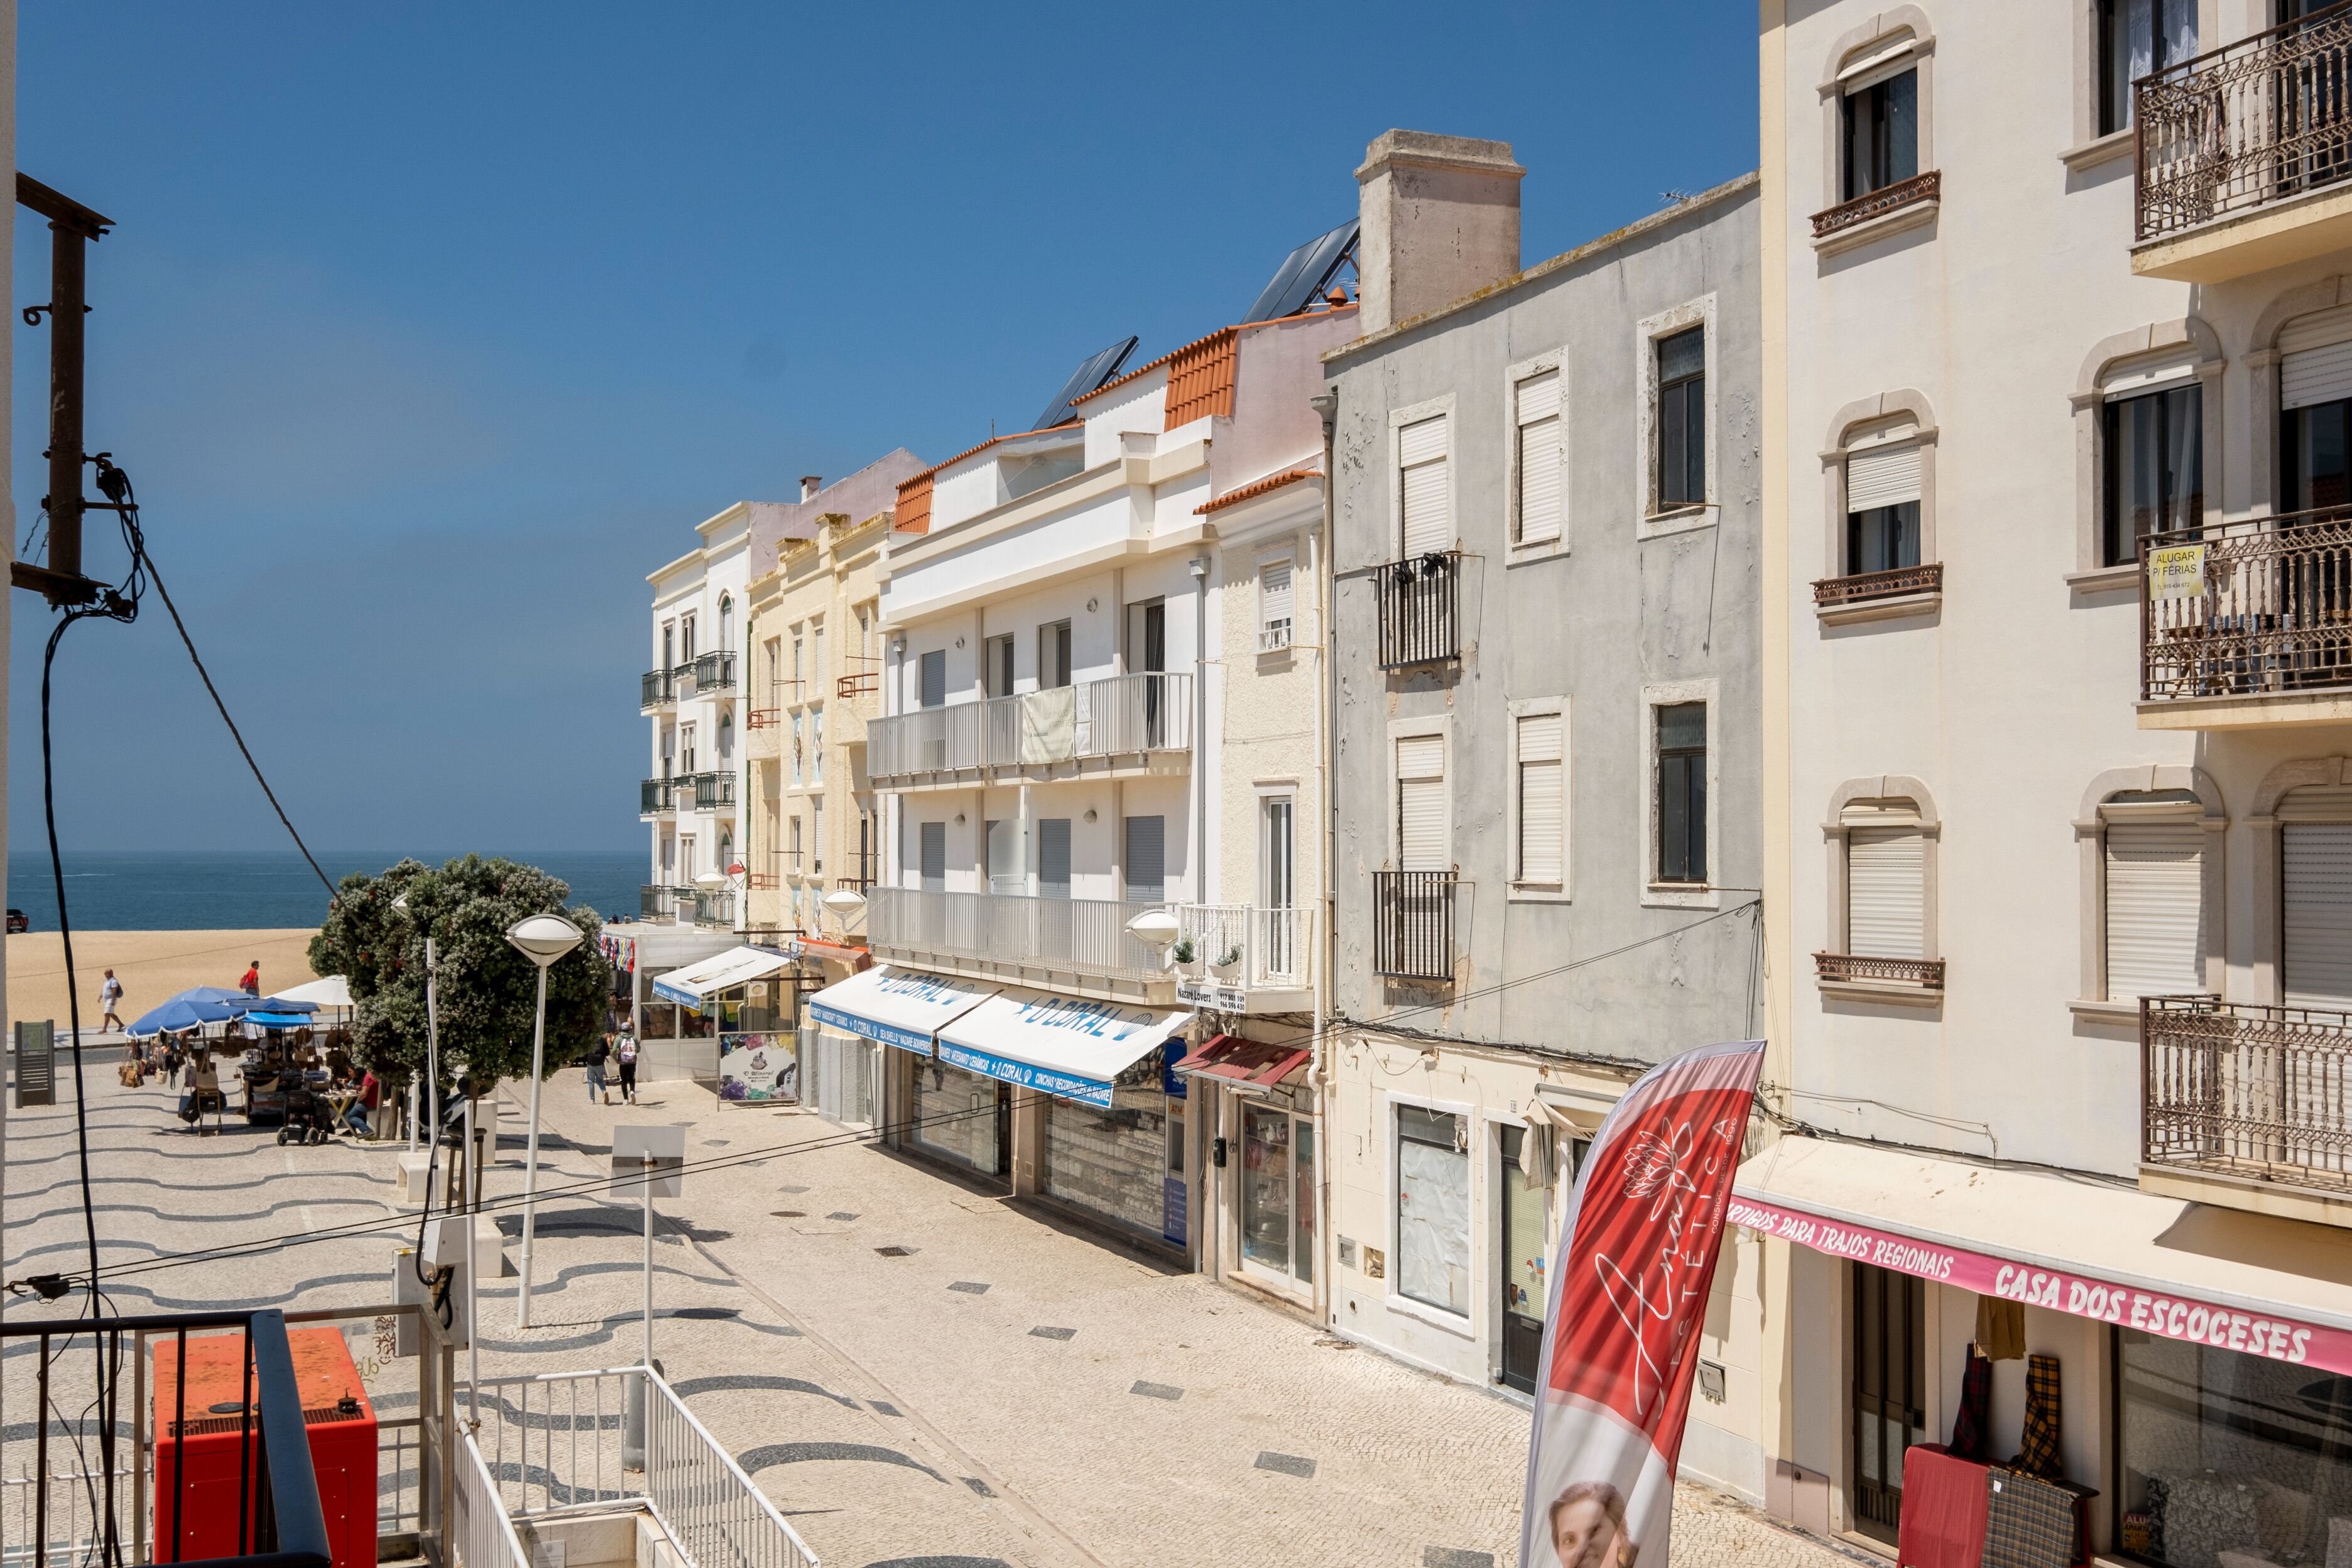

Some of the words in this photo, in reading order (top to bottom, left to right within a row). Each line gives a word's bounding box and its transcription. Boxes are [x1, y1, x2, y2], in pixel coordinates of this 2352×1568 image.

[2157, 551, 2194, 564] ALUGAR
[2153, 568, 2160, 577] P/
[2163, 564, 2196, 576] FÉRIAS
[881, 974, 911, 991] O
[892, 975, 955, 1002] CORAL
[1177, 988, 1193, 999] Nazaré
[1194, 990, 1211, 1002] Lovers
[1025, 998, 1060, 1023] O
[1042, 1001, 1123, 1037] CORAL
[853, 1020, 857, 1031] O
[858, 1021, 872, 1035] CORAL
[900, 1035, 913, 1047] NAZARÉ
[913, 1038, 931, 1052] SOUVENIRS
[996, 1062, 1000, 1075] O
[1000, 1064, 1023, 1081] CORAL
[1035, 1073, 1054, 1087] CONCHAS
[1172, 1104, 1182, 1114] ATM
[1712, 1190, 1723, 1234] CONSIGO
[1719, 1152, 1729, 1183] DESDE
[1726, 1118, 1738, 1145] 1990
[1670, 1118, 1729, 1366] ESTÉTICA
[1776, 1216, 1817, 1244] PARA
[1817, 1226, 1872, 1258] TRAJOS
[1872, 1239, 1954, 1278] REGIONAIS
[1996, 1265, 2061, 1308] CASA
[2068, 1281, 2126, 1321] DOS
[2131, 1293, 2311, 1363] ESCOCESES
[2126, 1515, 2149, 1524] ALU
